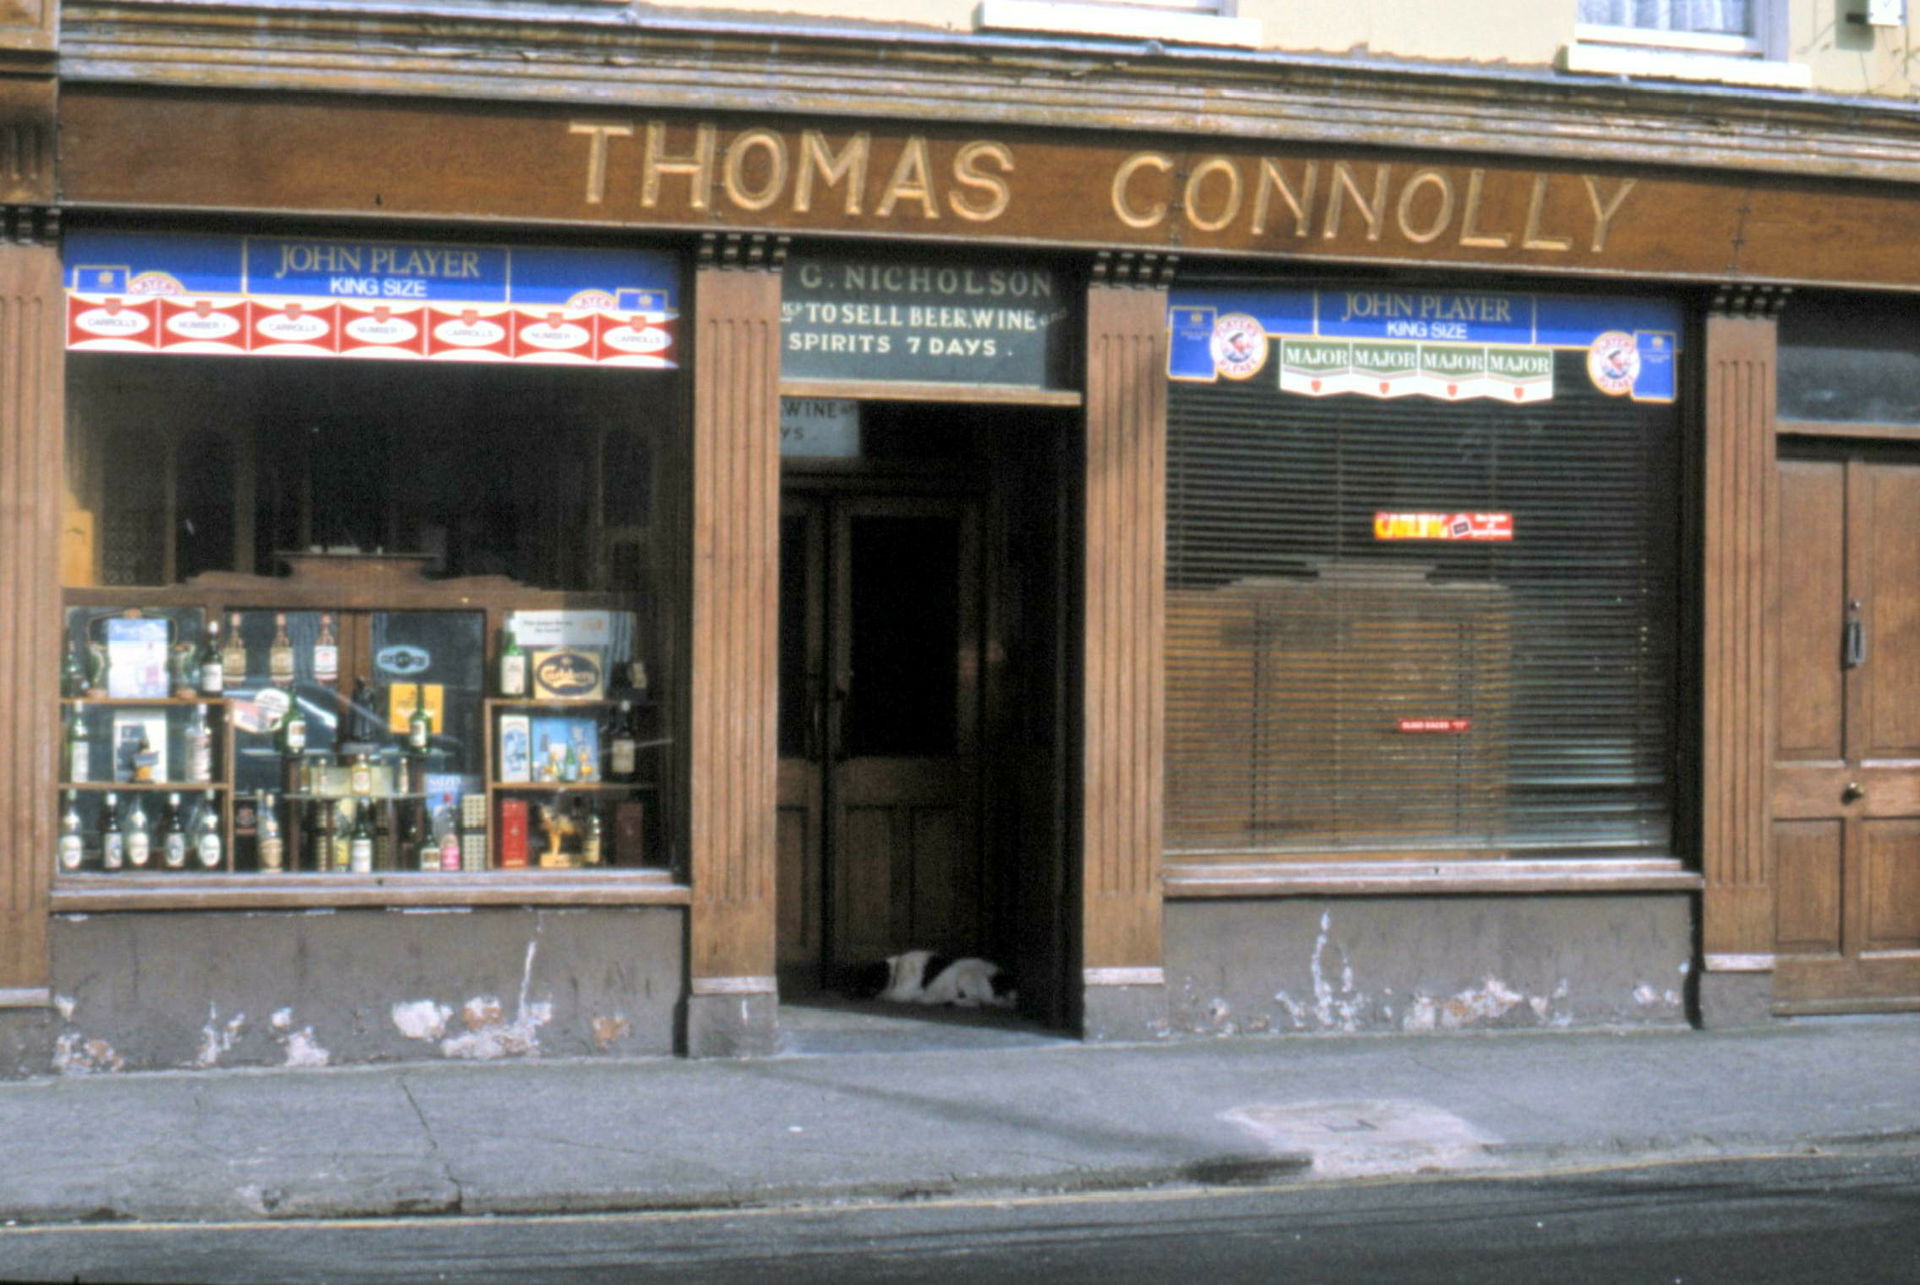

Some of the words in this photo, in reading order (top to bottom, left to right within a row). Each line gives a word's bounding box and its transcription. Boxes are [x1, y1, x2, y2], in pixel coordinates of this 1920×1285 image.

[568, 119, 1015, 222] THOMAS
[1111, 151, 1639, 254] CONNOLLY
[274, 243, 362, 278] JOHN
[370, 246, 481, 278] PLAYER
[330, 276, 379, 296] KING
[383, 278, 428, 297] SIZE
[843, 264, 1052, 297] NICHOLSON
[804, 302, 838, 325] TO
[841, 304, 903, 326] SELL
[971, 308, 1038, 331] WINE
[1341, 292, 1413, 321] JOHN
[1420, 294, 1512, 322] PLAYER
[1386, 320, 1427, 337] KING
[1431, 322, 1468, 339] SIZE
[788, 332, 892, 353] SPIRITS
[906, 337, 921, 355] 7
[1285, 347, 1348, 366] MAJOR
[1354, 350, 1417, 368] MAJOR
[1423, 352, 1485, 370] MAJOR
[1489, 354, 1550, 373] MAJOR
